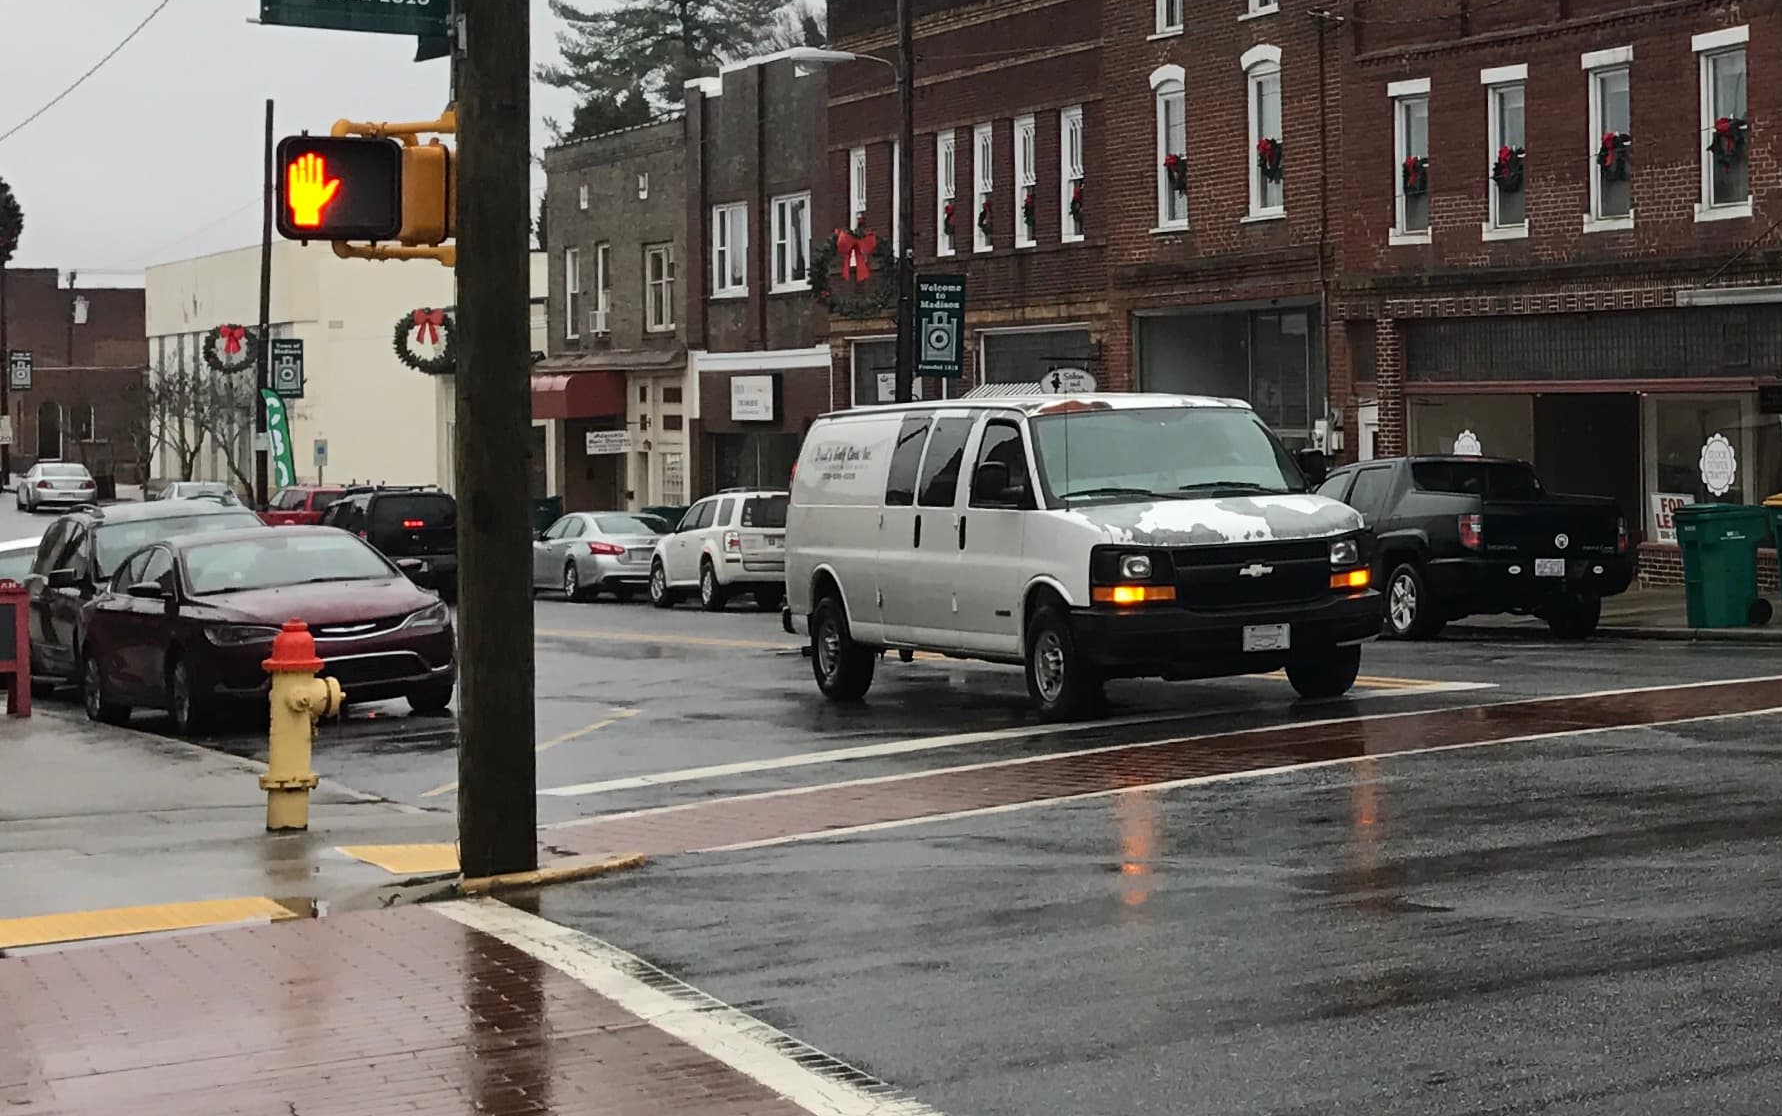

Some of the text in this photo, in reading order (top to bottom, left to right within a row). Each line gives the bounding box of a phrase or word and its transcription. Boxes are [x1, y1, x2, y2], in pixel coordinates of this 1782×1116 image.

[919, 283, 962, 292] Welcome
[935, 291, 946, 300] to
[920, 300, 961, 309] Madison
